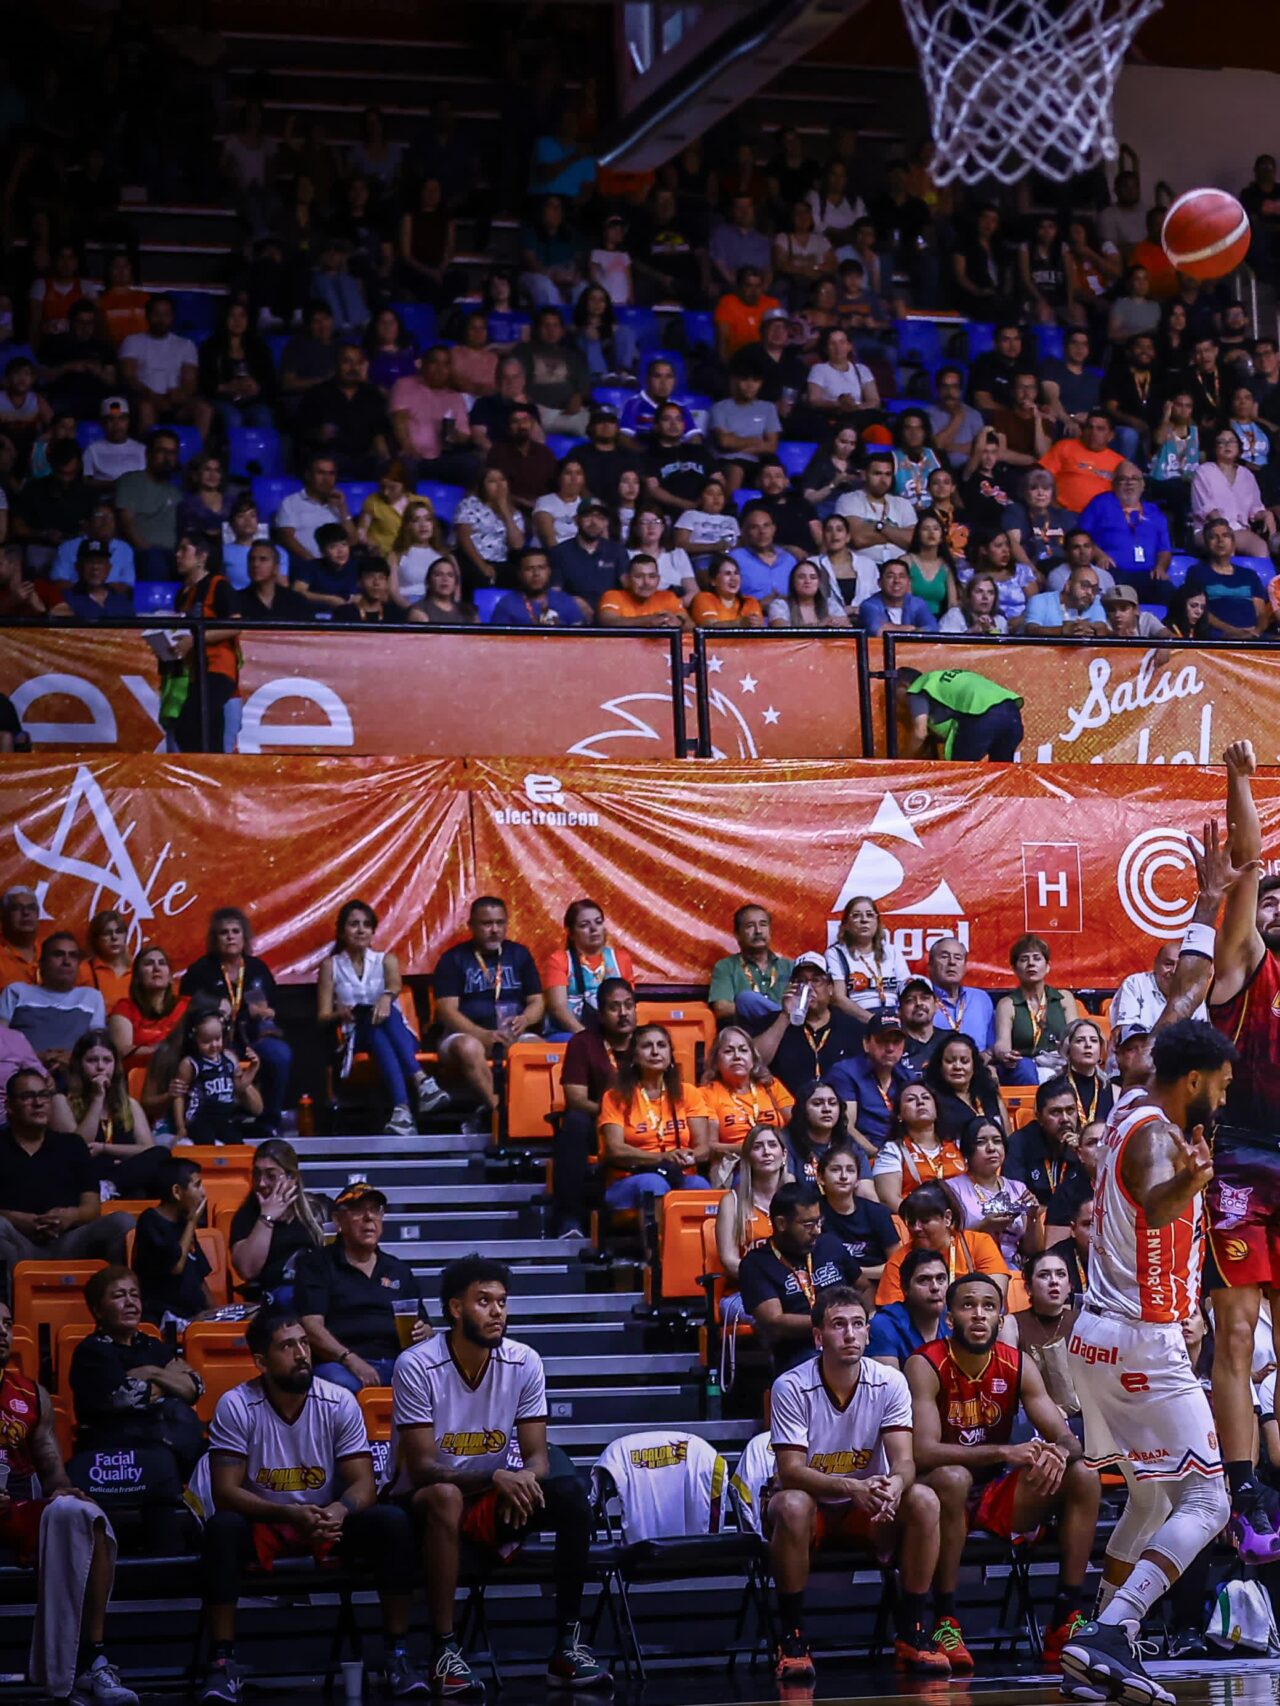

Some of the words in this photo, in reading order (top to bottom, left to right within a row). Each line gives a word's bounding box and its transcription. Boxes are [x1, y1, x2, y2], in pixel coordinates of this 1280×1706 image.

[1058, 651, 1205, 742] Salsa
[1145, 1226, 1166, 1306] ENWORTH
[1069, 1335, 1119, 1366] Dagal
[94, 1449, 136, 1467] Facial
[1141, 1448, 1170, 1461] BAJA
[88, 1466, 143, 1485] Quality
